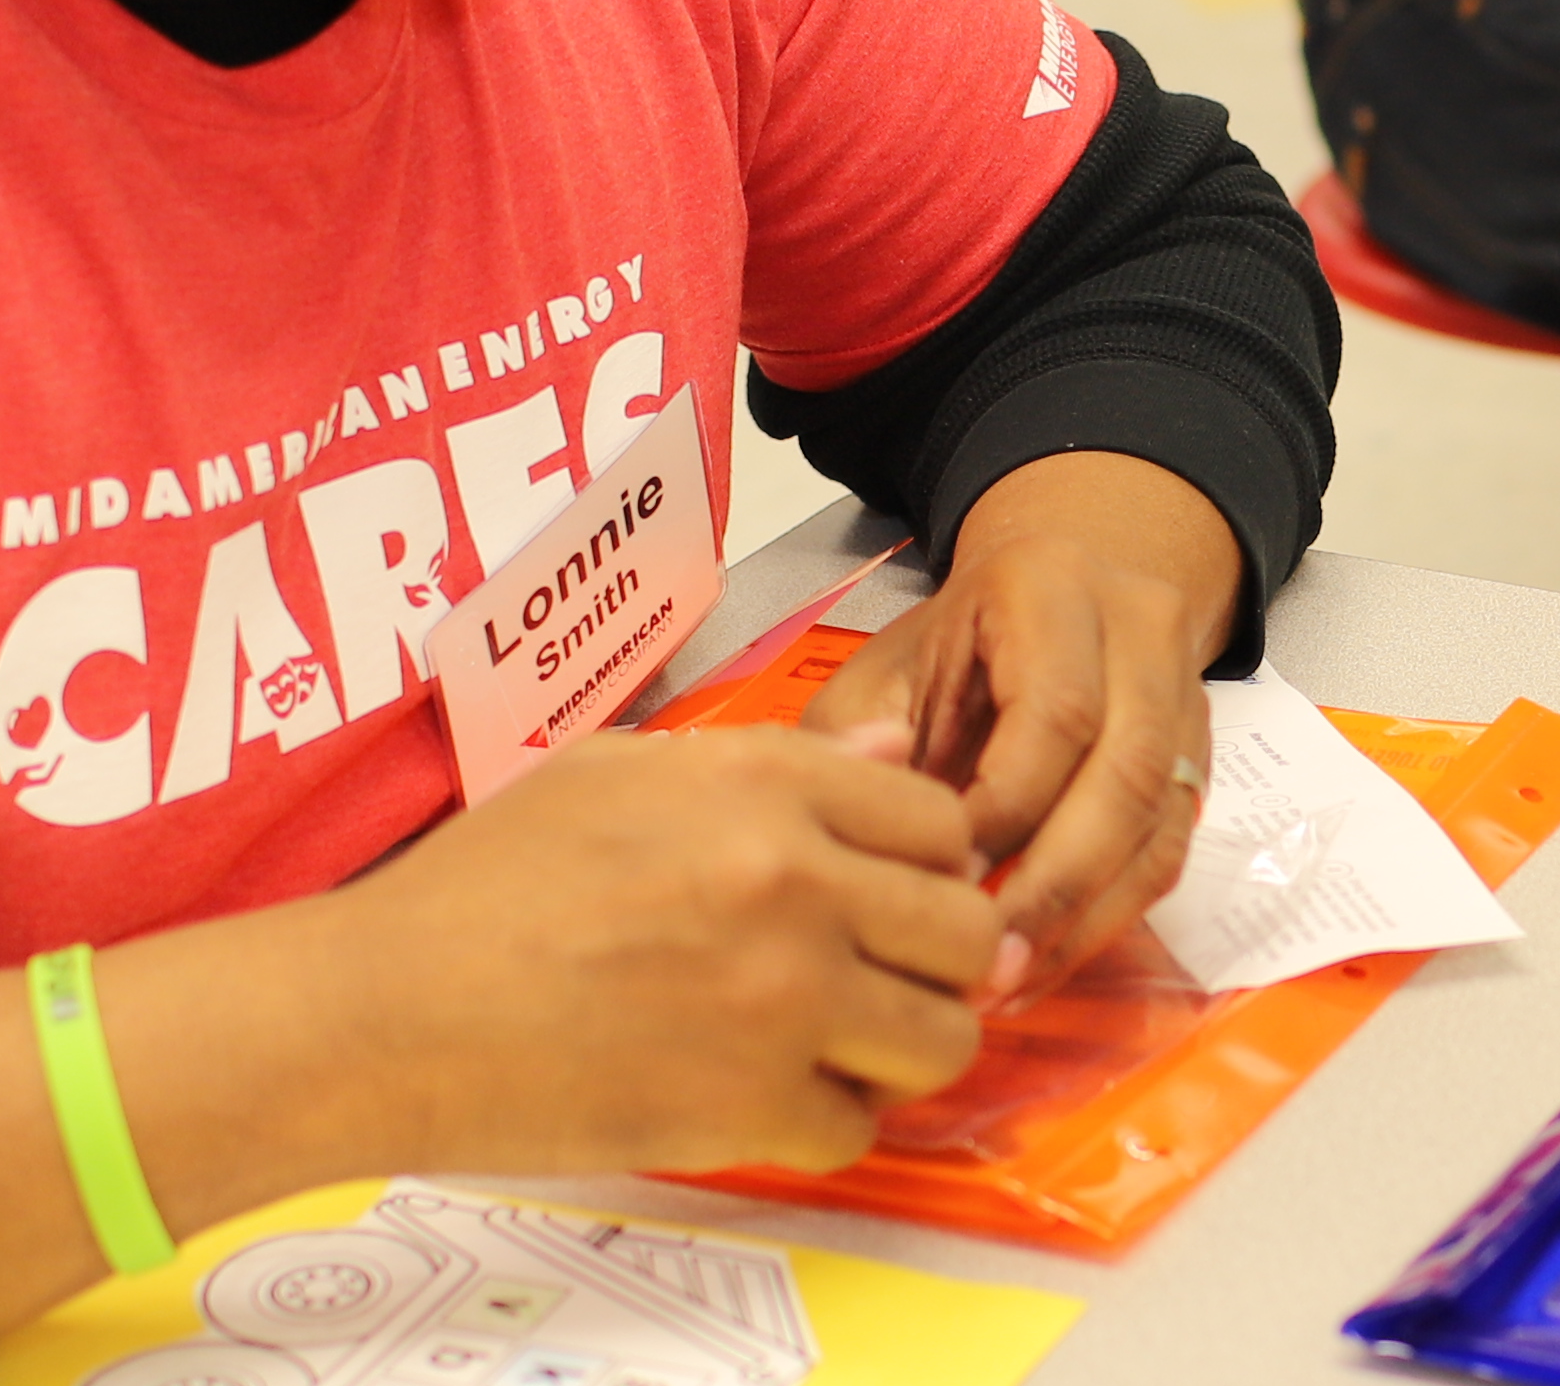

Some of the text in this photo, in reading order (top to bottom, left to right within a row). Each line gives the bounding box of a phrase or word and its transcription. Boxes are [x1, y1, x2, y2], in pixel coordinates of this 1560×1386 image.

[437, 253, 644, 393] ENERGY
[483, 476, 665, 669] Lonnie
[535, 568, 640, 682] Smith
[546, 597, 673, 732] MIDAMERICAN
[549, 612, 676, 745] ENERGY COMPANY
